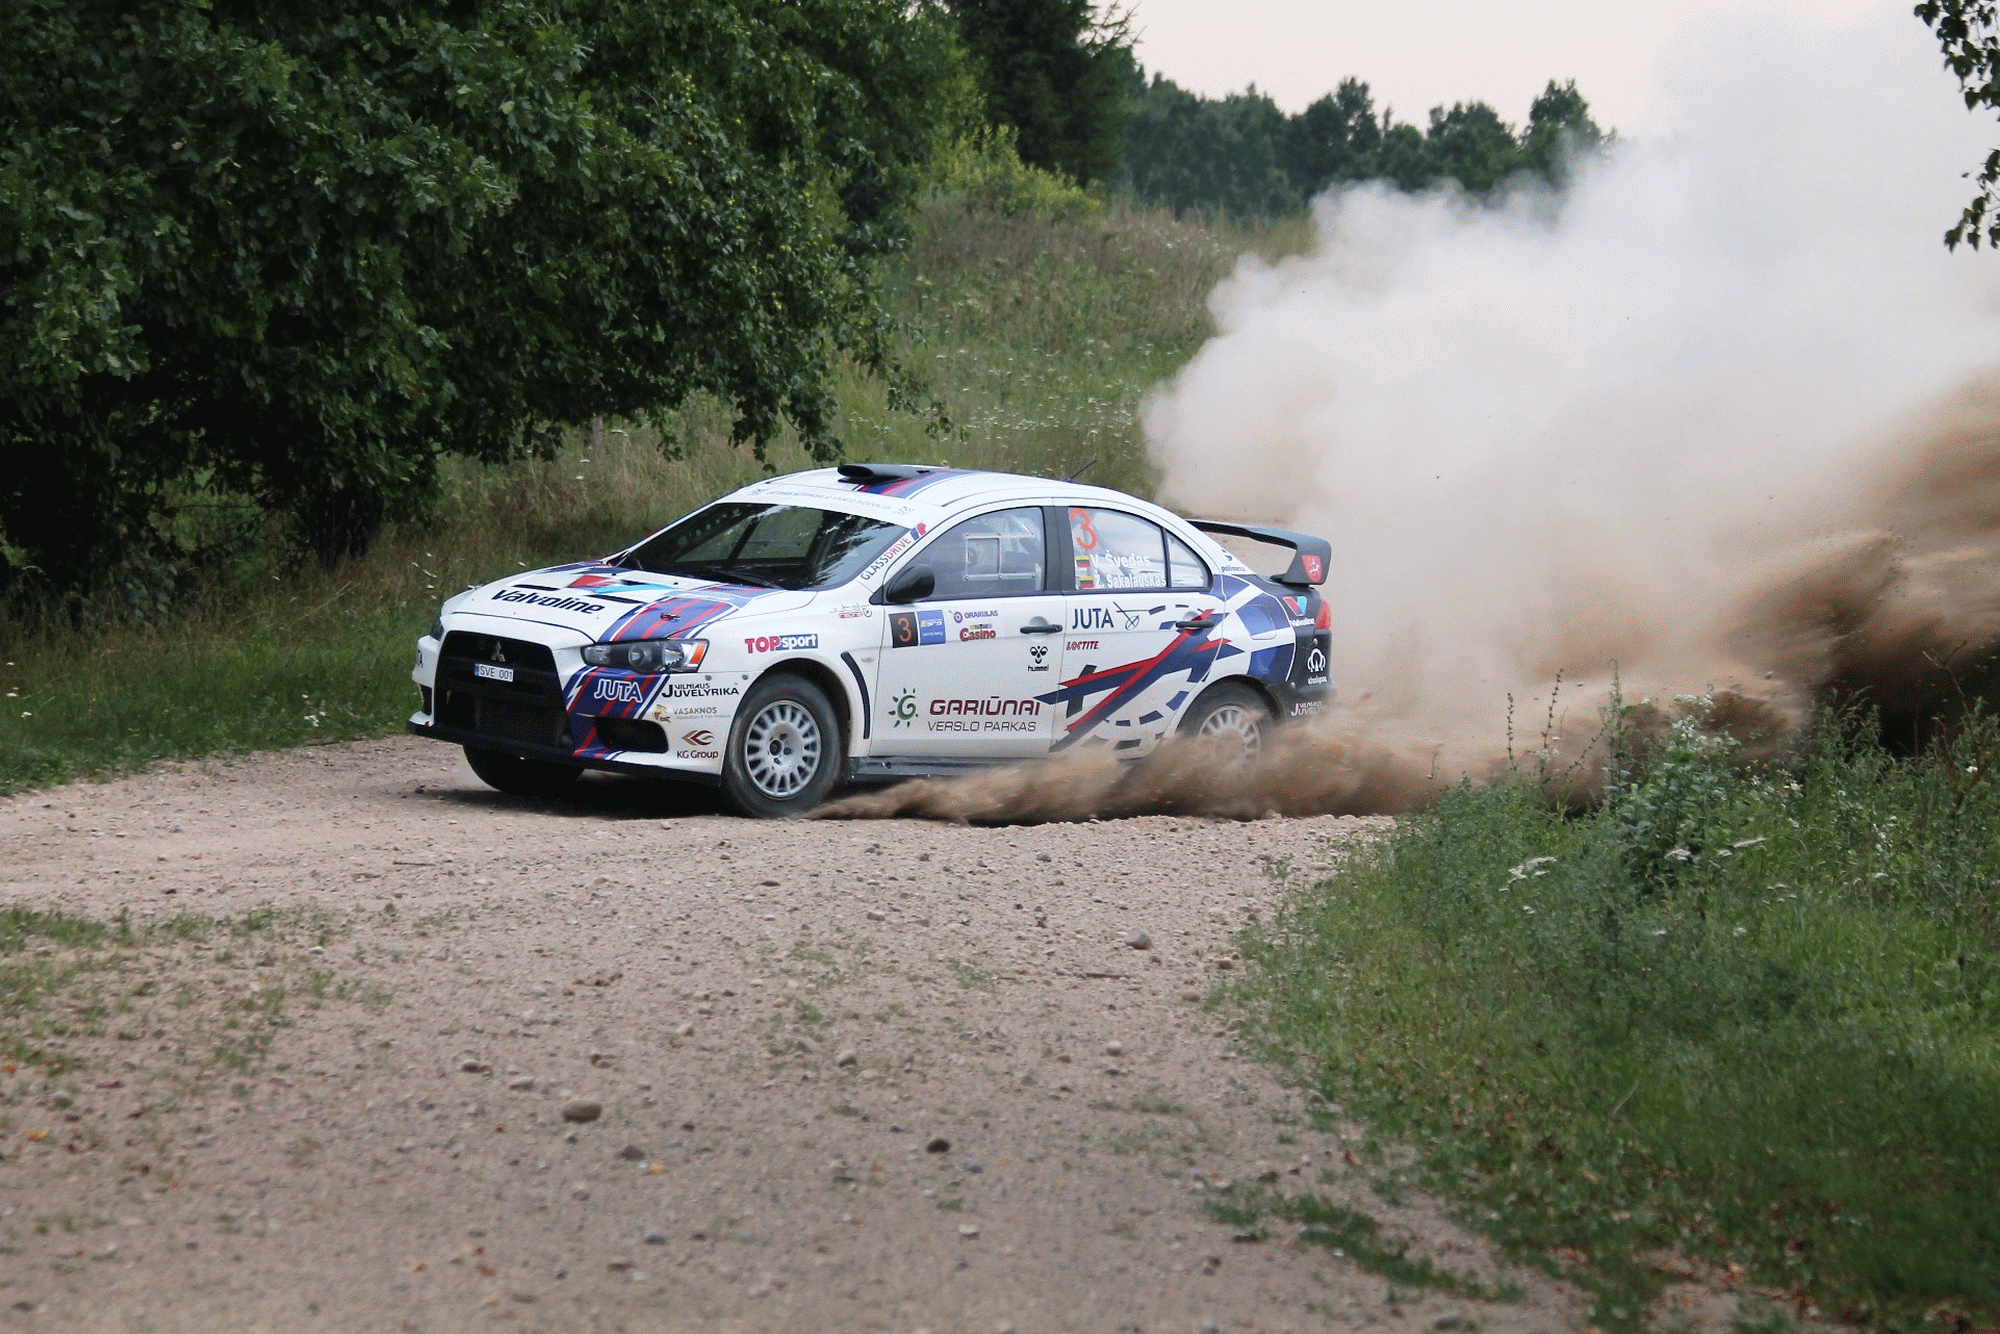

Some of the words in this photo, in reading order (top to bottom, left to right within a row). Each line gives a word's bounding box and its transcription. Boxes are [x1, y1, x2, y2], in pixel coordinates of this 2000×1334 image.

[1069, 507, 1098, 550] 3
[861, 537, 912, 581] GLASSDRIVE
[1105, 549, 1151, 568] Švedas
[1106, 573, 1167, 588] Sakalauskas
[492, 590, 605, 614] Valvoline
[964, 610, 998, 619] ORAKULAS
[1072, 608, 1114, 629] JUTA
[898, 617, 911, 642] 3
[959, 627, 996, 642] Casino
[1066, 641, 1099, 650] LOCTITE
[480, 666, 495, 677] SVE
[499, 669, 513, 680] 001
[1028, 664, 1049, 672] hummel
[594, 679, 643, 703] JUTA
[673, 706, 718, 715] VASAKNOS
[929, 696, 1041, 716] GARIŪNAI
[927, 721, 980, 732] VERSLO
[984, 721, 1037, 732] PARKAS
[677, 750, 689, 759] KG
[690, 750, 719, 760] Group
